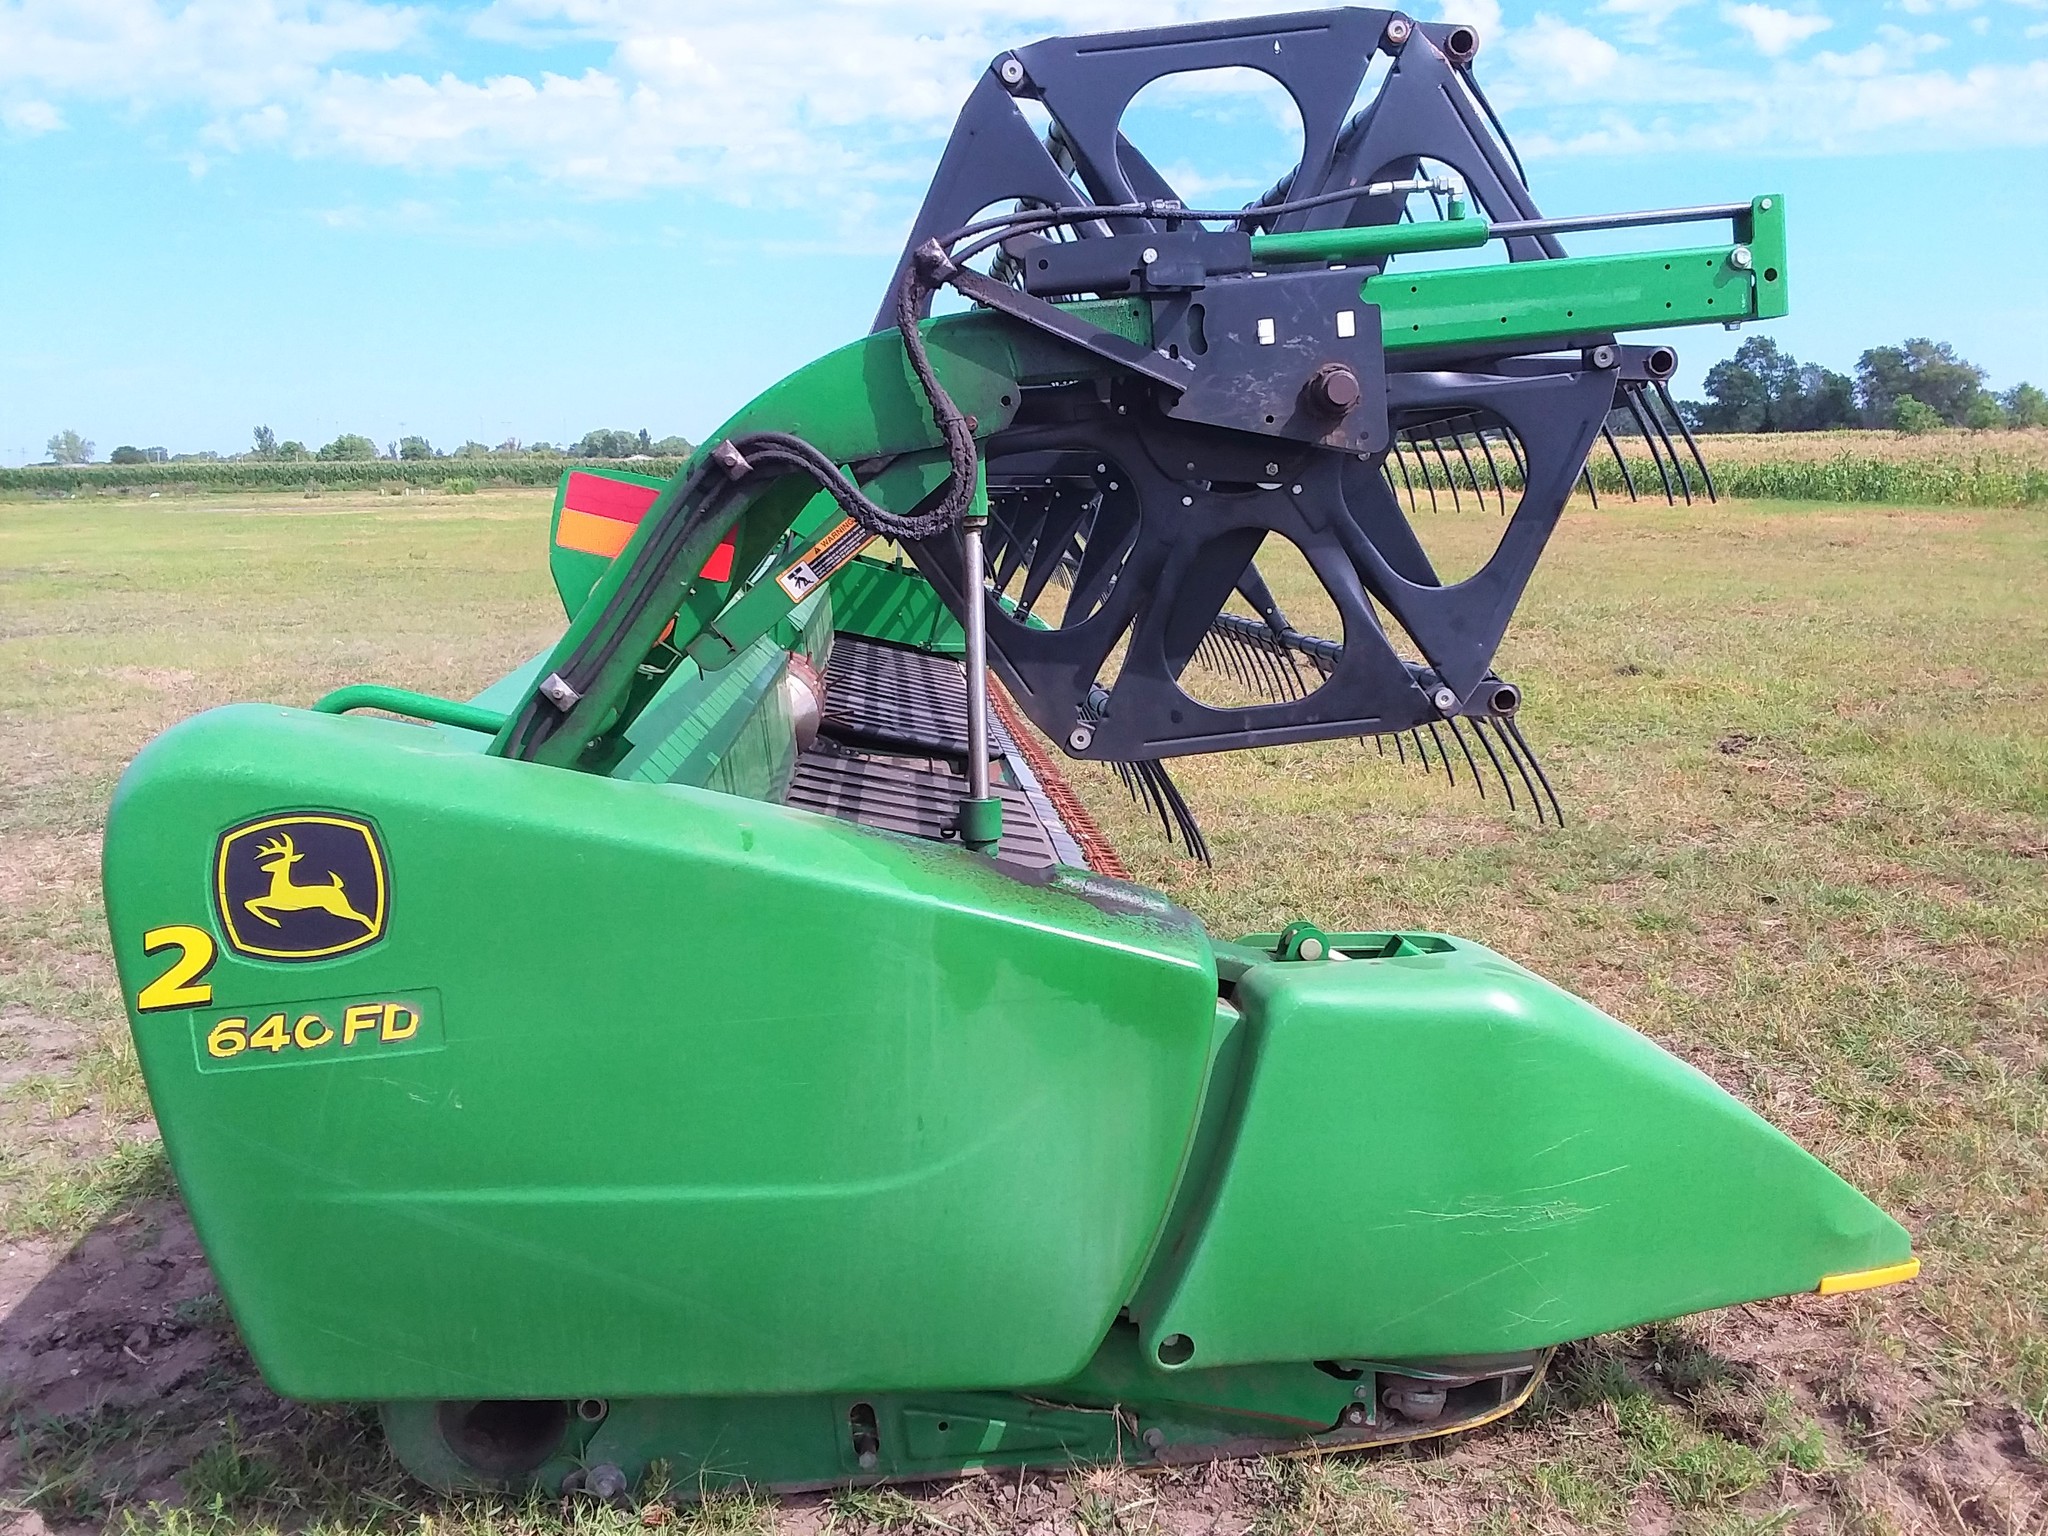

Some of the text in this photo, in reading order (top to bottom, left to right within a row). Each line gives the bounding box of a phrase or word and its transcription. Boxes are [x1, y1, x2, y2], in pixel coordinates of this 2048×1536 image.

[820, 517, 855, 548] WARNING
[138, 924, 217, 1014] 2
[207, 1003, 419, 1058] 640 FD
